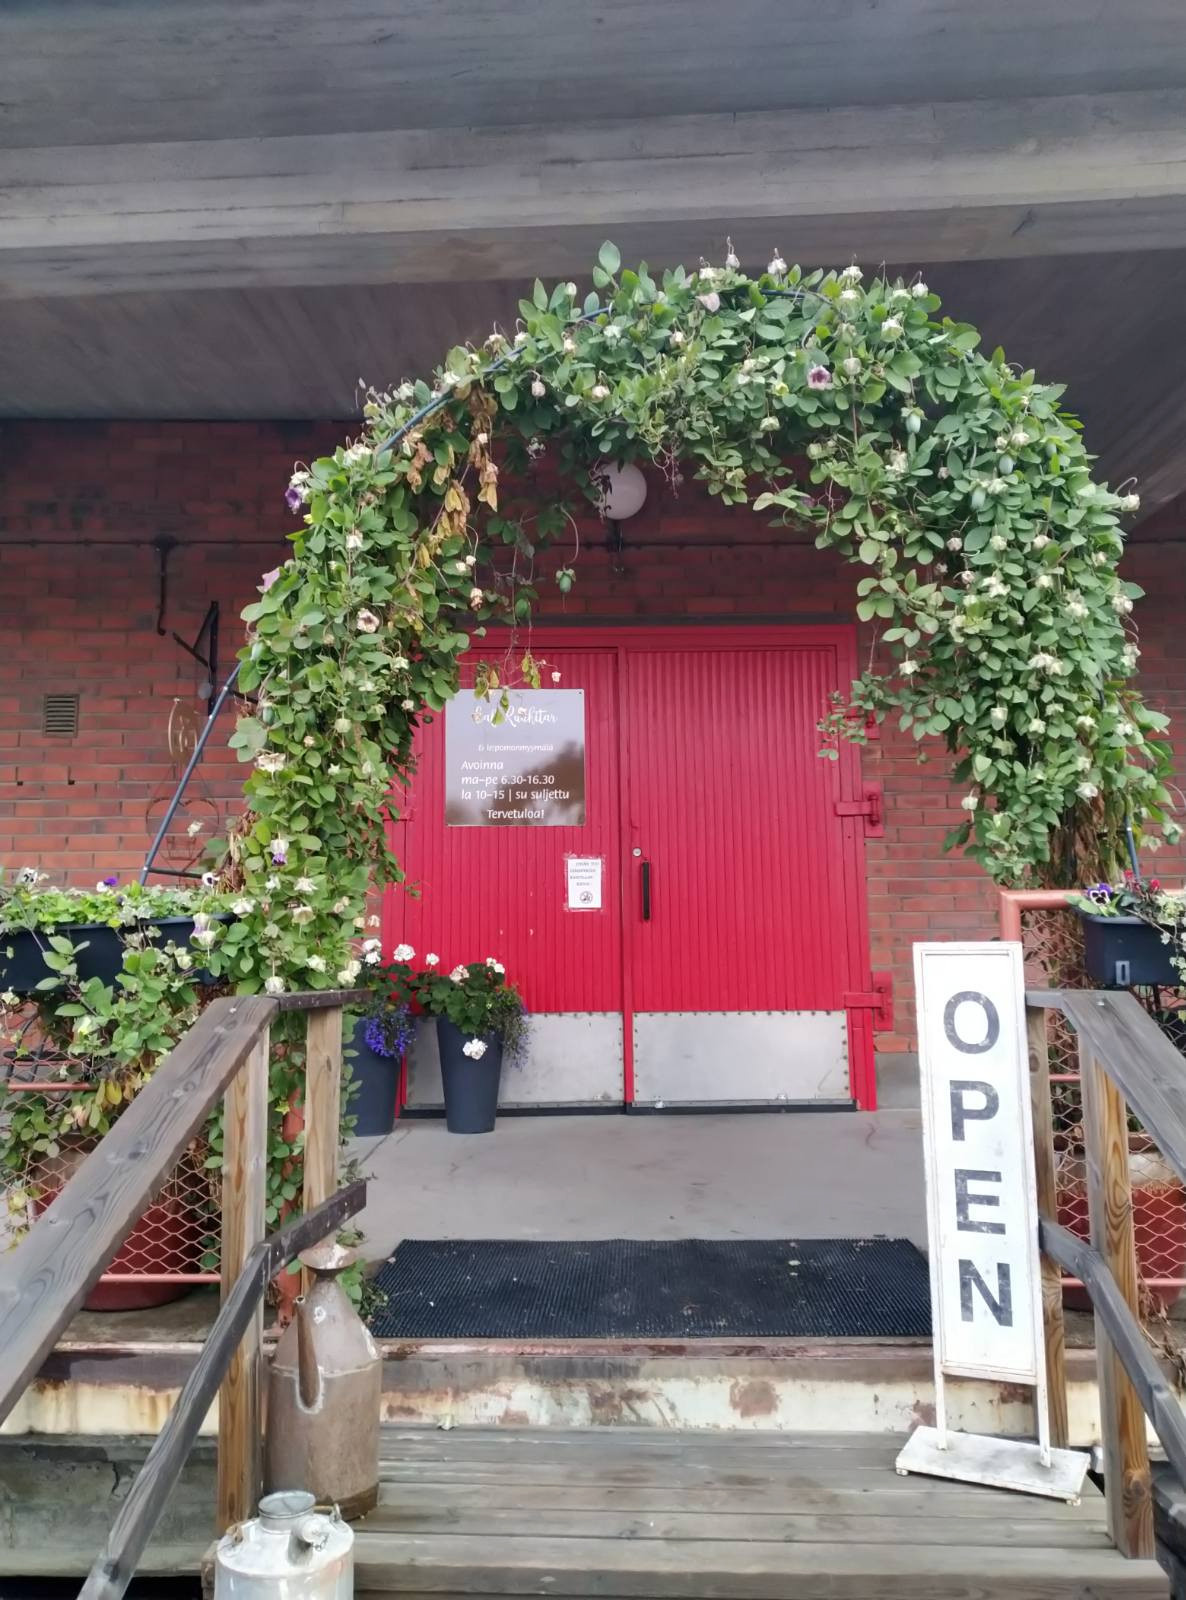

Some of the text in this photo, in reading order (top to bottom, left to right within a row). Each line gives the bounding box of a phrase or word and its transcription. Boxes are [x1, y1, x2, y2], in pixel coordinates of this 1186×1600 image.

[460, 760, 504, 770] Avoinna
[501, 775, 555, 785] 6.30-16.30
[461, 789, 472, 800] la
[515, 791, 528, 800] su
[530, 789, 570, 802] suljettu
[487, 809, 545, 819] Tervetuloa!
[943, 990, 1014, 1328] OPEN
